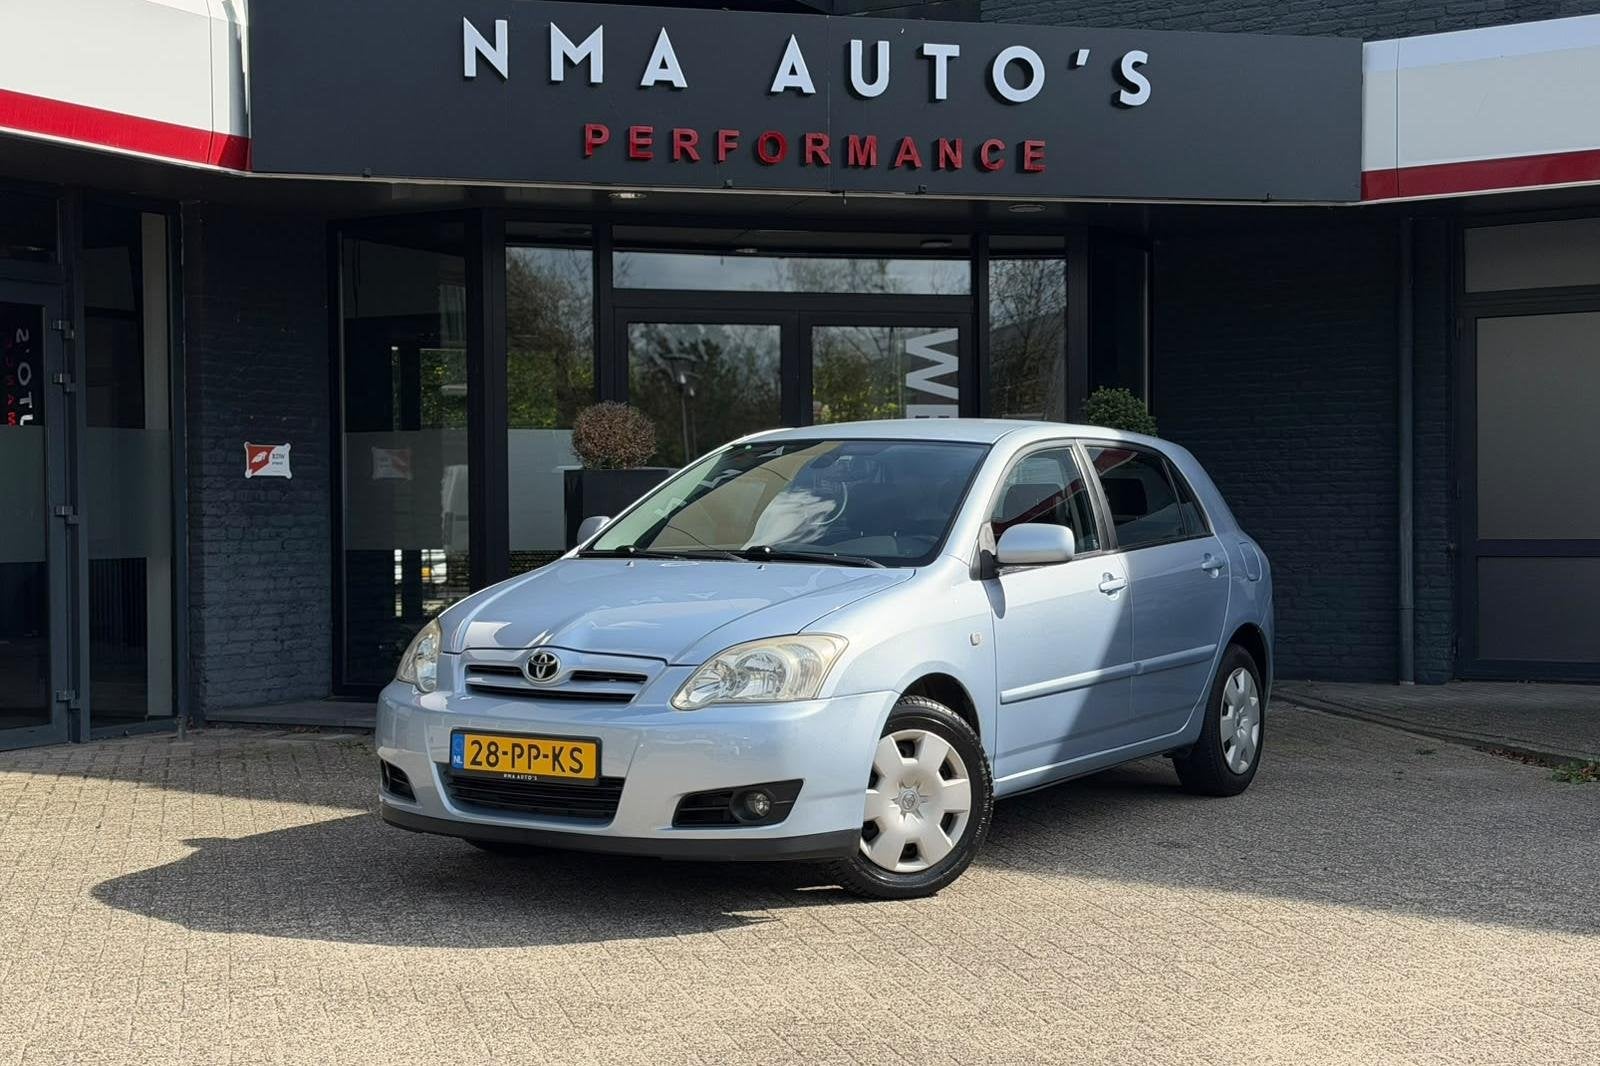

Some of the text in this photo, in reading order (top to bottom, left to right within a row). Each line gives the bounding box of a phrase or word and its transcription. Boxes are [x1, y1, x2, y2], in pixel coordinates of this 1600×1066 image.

[462, 17, 1152, 106] NMA AUTO'S
[583, 123, 1047, 173] PERFORMANCE
[453, 755, 463, 765] NL
[470, 739, 584, 775] 28-PP-KS
